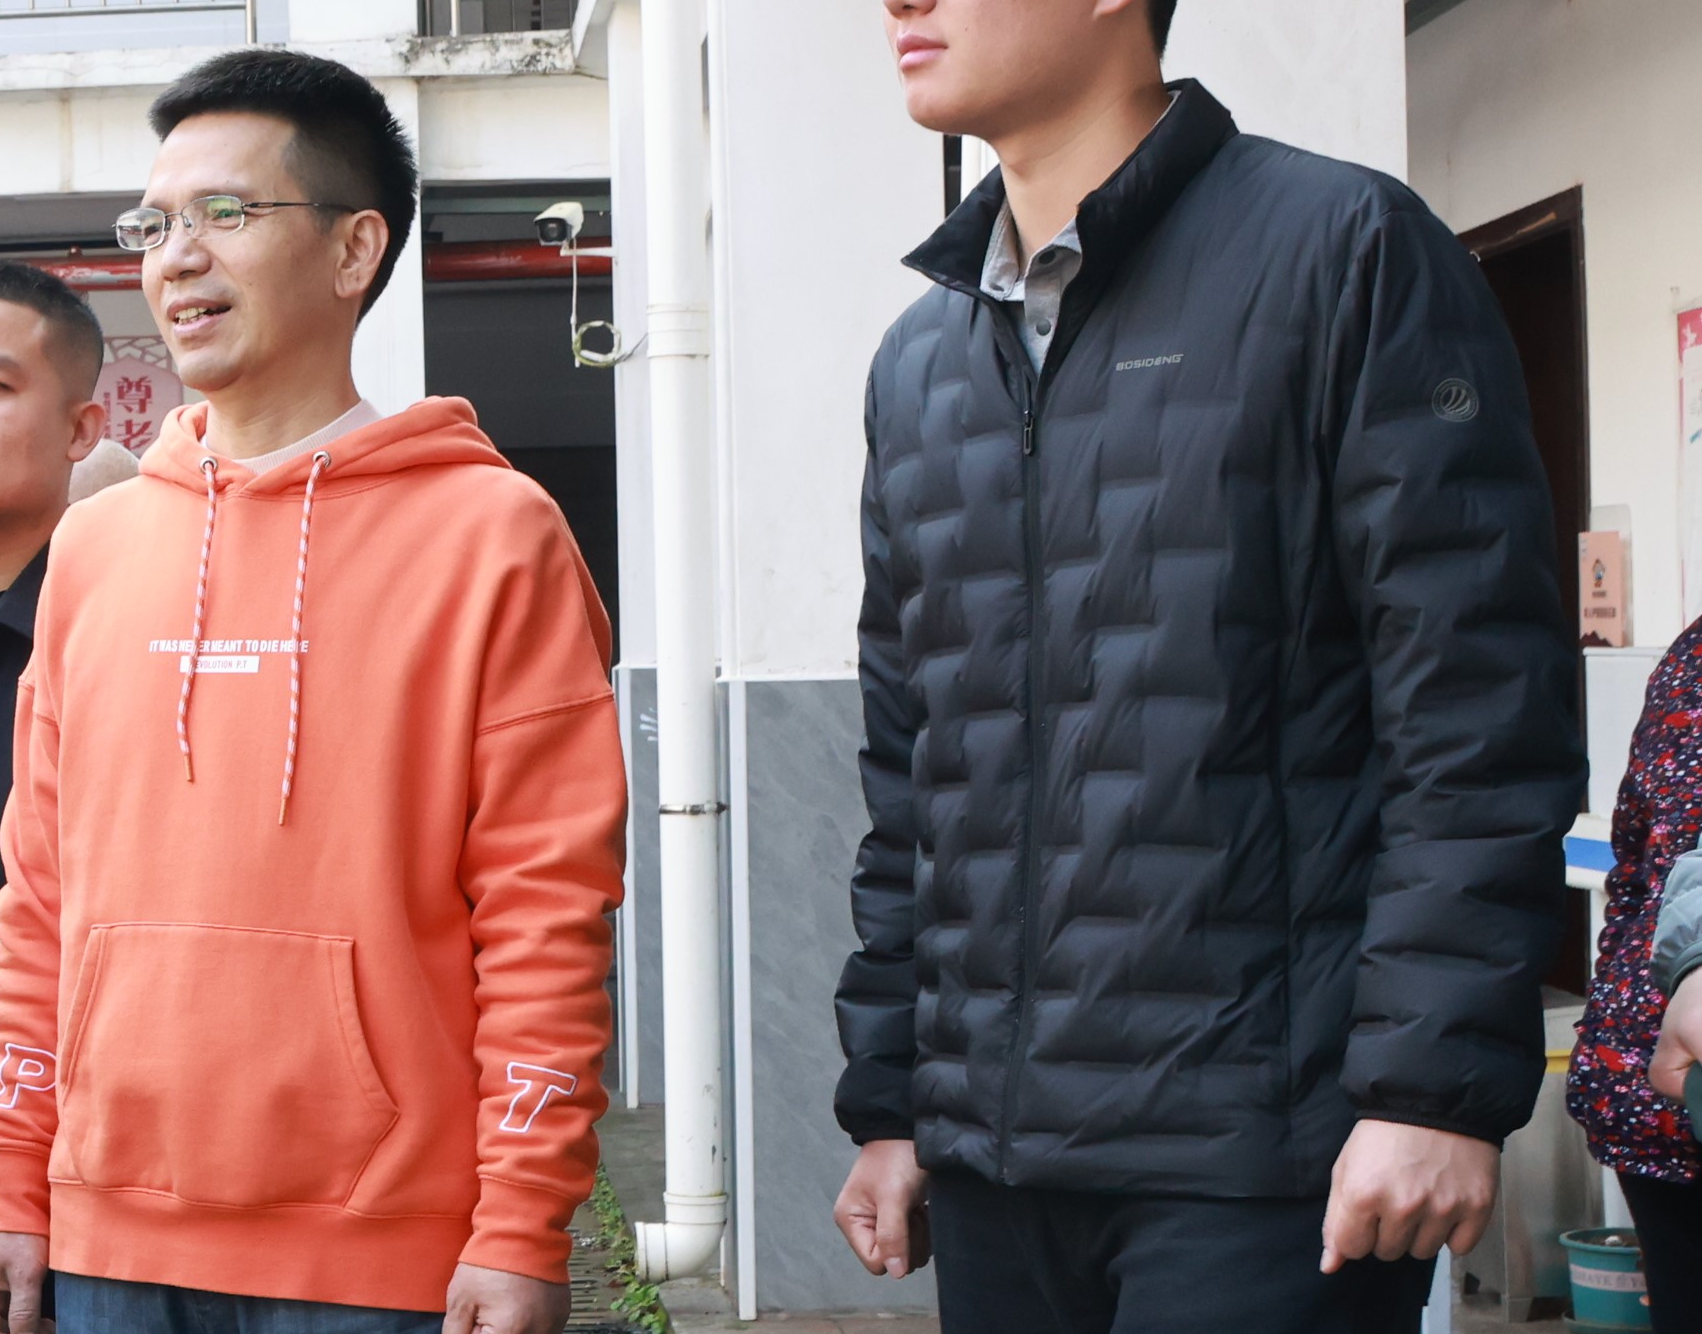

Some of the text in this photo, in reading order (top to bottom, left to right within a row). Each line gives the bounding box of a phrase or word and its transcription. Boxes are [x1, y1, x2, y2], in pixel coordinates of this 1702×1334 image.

[1116, 354, 1184, 371] BOSIDENG
[149, 640, 159, 652] IT
[159, 640, 179, 652] WAS
[179, 640, 210, 652] NEER
[211, 640, 244, 652] MEANT
[246, 640, 260, 652] TO
[260, 640, 279, 652] DIE
[193, 659, 233, 670] EVOLUTION
[499, 1061, 578, 1133] T
